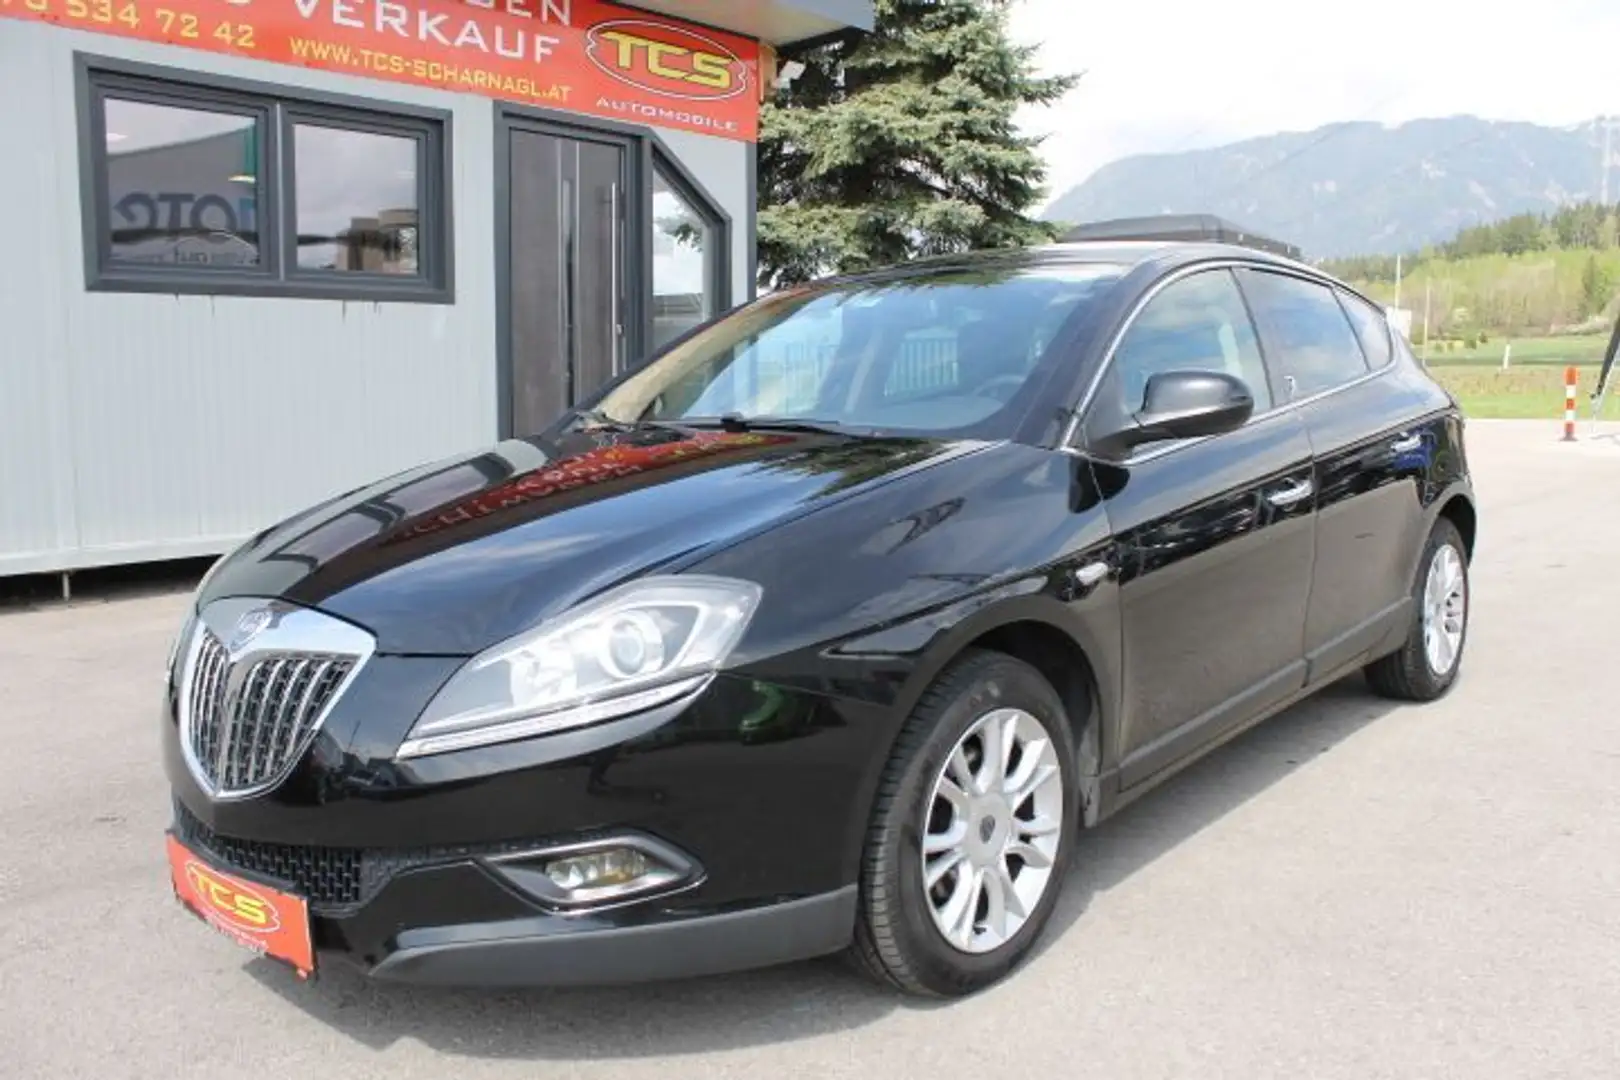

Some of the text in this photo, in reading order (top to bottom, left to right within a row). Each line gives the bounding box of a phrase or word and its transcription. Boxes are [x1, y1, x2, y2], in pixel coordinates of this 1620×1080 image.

[65, 0, 140, 29] 534
[155, 8, 199, 38] 72
[213, 21, 256, 48] 42
[294, 0, 561, 63] VERKAUF
[289, 36, 572, 101] WWW.TCS-SCHARNAGL.AT
[601, 31, 732, 89] TCS
[596, 97, 739, 133] AUTOMOBILE
[196, 875, 267, 924] TCS
